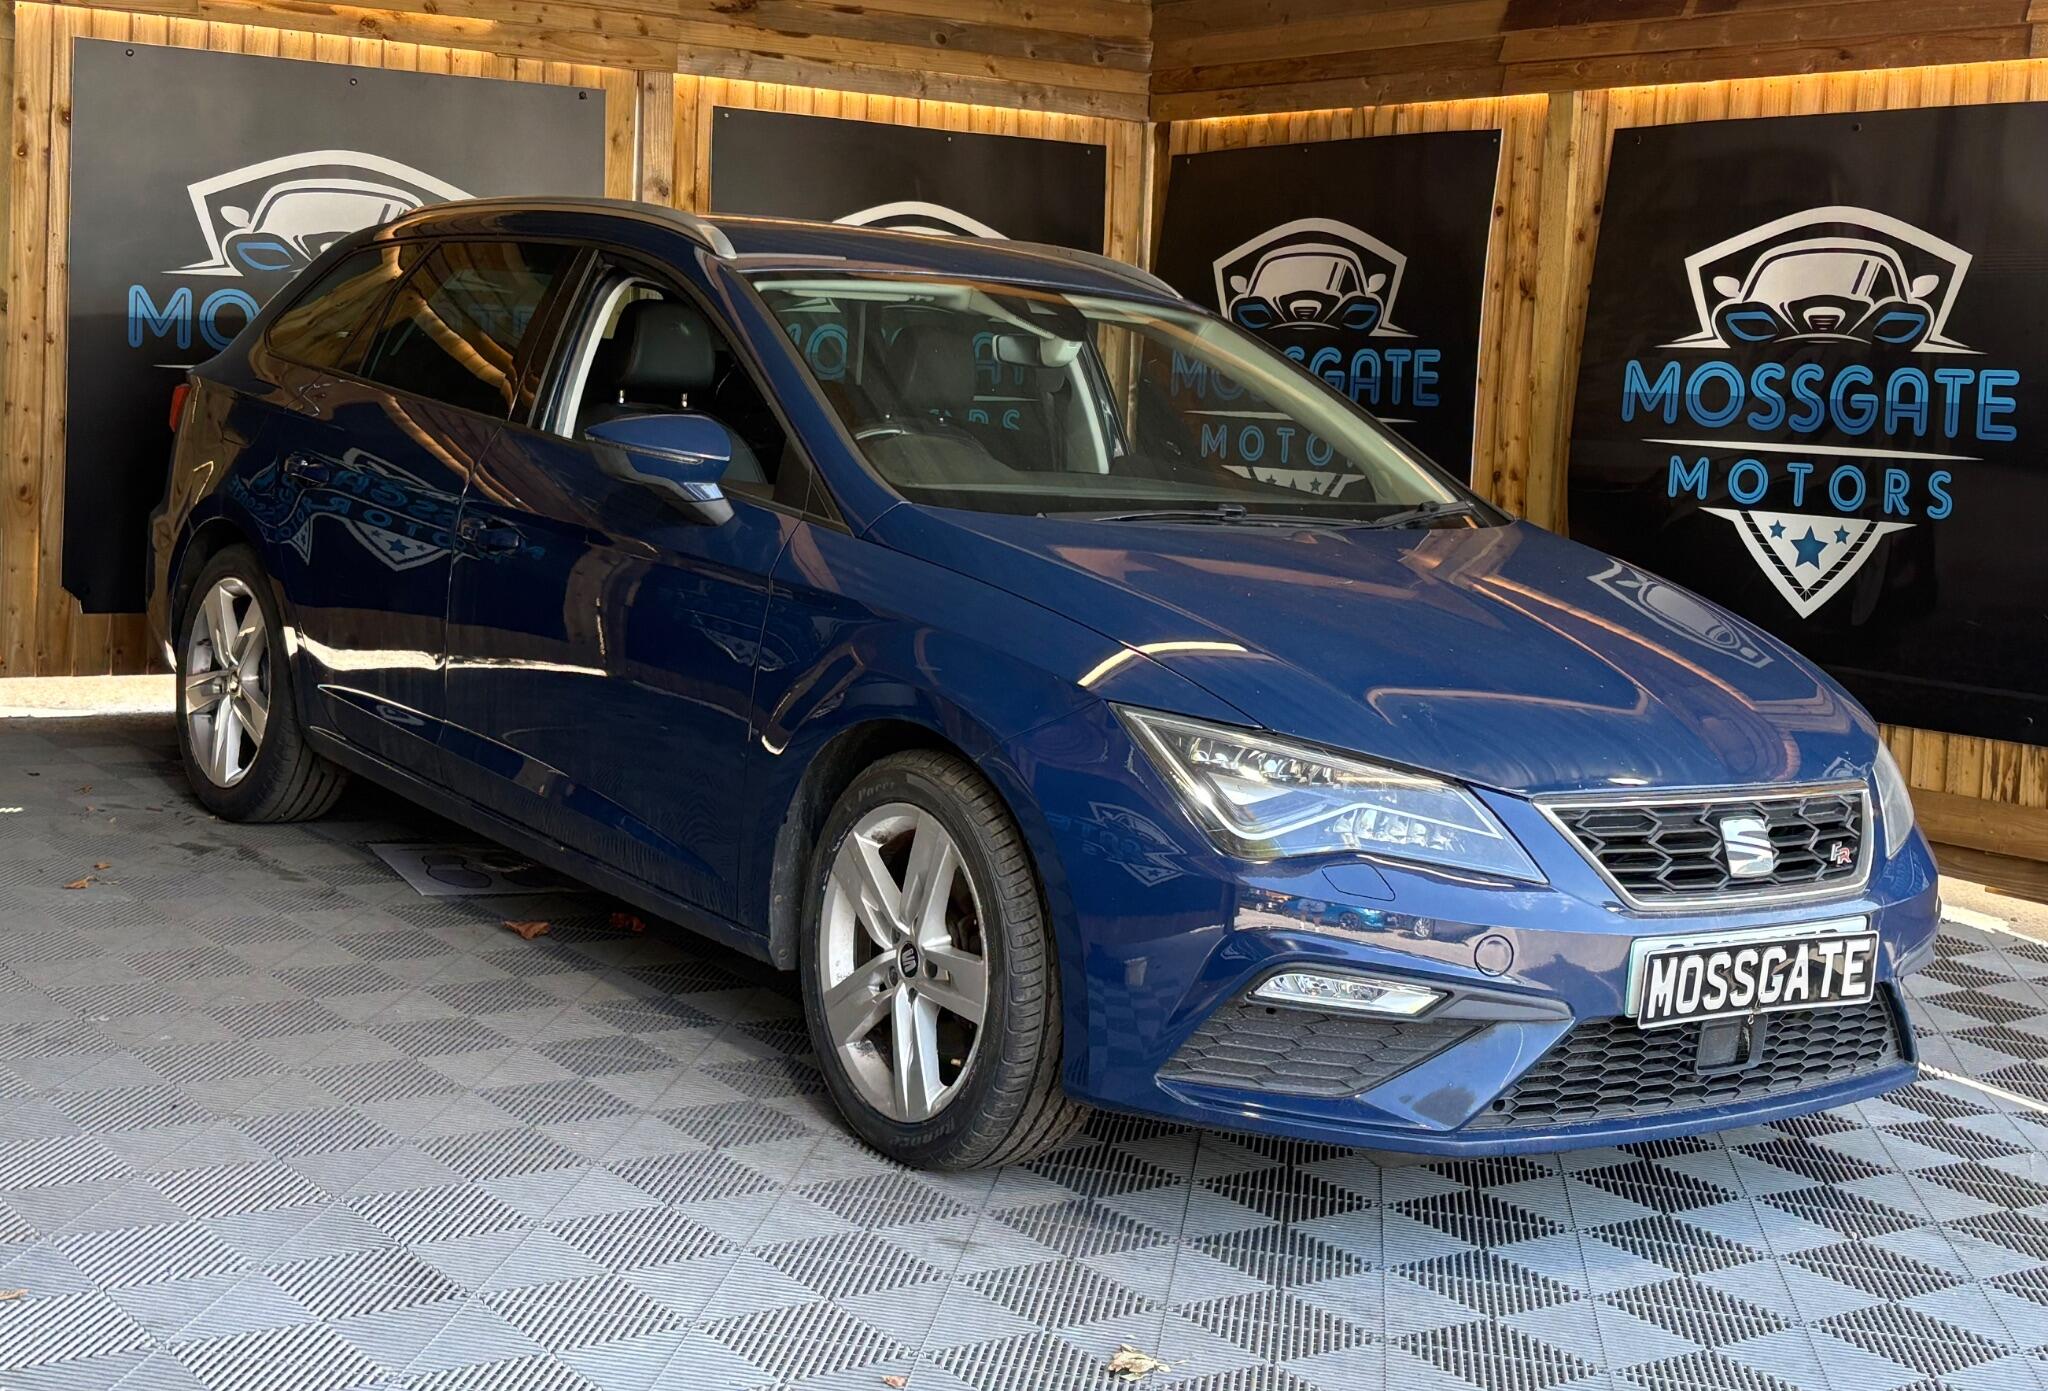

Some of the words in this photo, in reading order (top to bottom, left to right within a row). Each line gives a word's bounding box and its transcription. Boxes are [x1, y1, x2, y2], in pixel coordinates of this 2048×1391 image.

[1170, 344, 1442, 408] MOGATE
[1621, 359, 2020, 442] MOSSGATE
[1201, 423, 1355, 467] MOTO
[1667, 455, 1953, 520] MOTORS
[1648, 938, 1870, 1018] MOSSGATE
